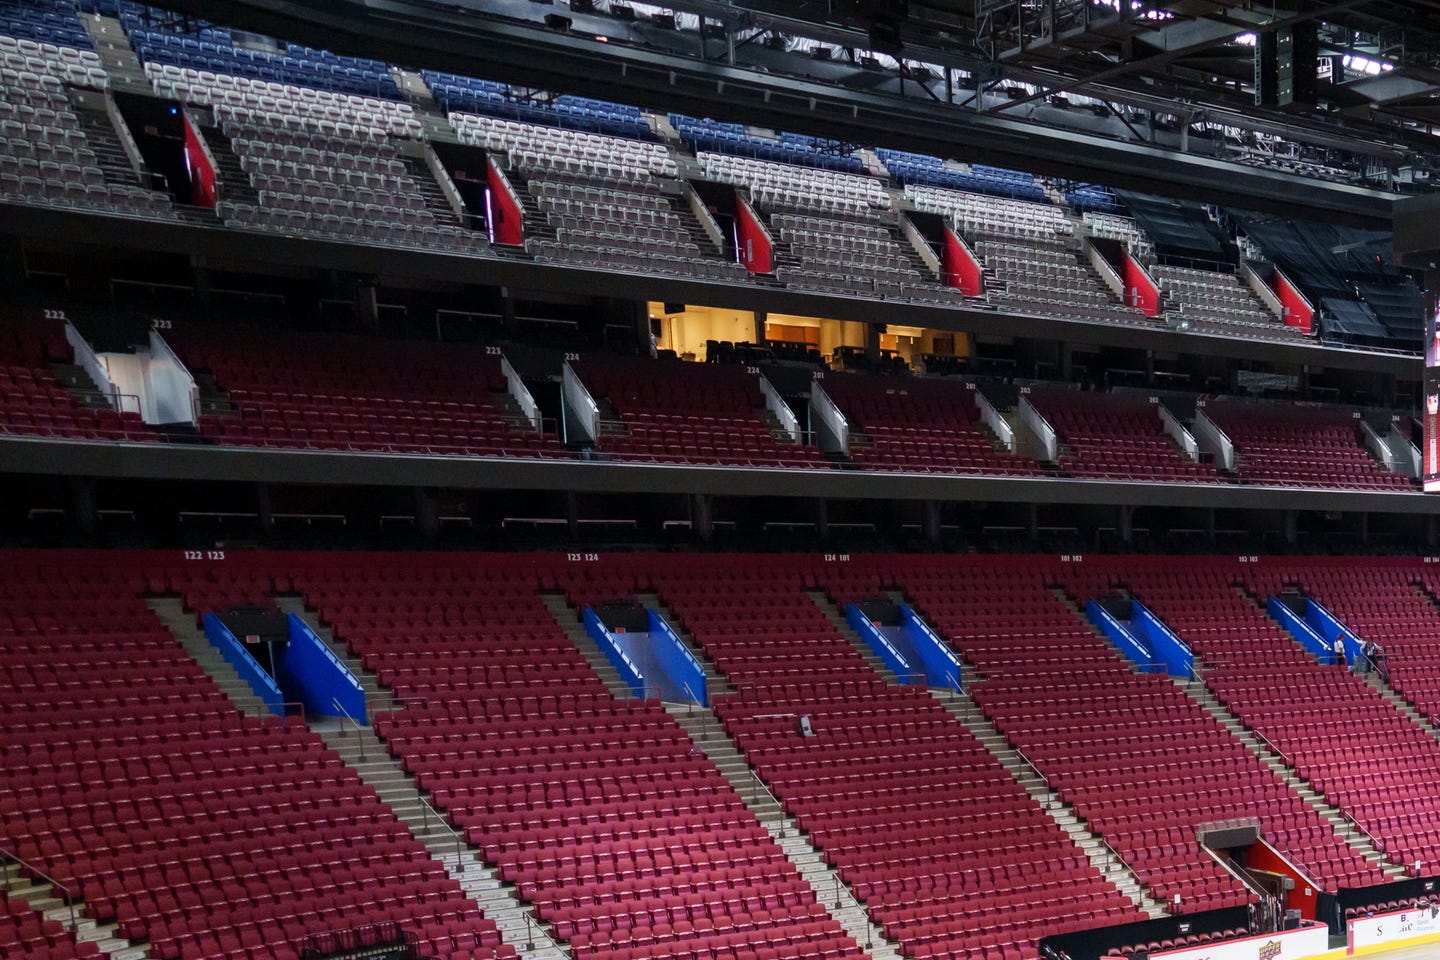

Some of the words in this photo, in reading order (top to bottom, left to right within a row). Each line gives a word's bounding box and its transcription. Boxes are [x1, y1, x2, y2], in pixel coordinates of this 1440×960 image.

[45, 309, 66, 319] 222
[154, 319, 173, 329] 223
[486, 346, 501, 355] 223
[565, 352, 580, 361] 224
[747, 366, 760, 375] 224
[813, 372, 825, 380] 201
[965, 383, 976, 391] 201
[185, 551, 203, 560] 122
[208, 551, 225, 560] 123
[567, 553, 581, 562] 123
[585, 553, 600, 562] 124
[824, 554, 836, 562] 124
[840, 554, 850, 562] 101
[1061, 555, 1070, 563] 101
[1073, 555, 1083, 563] 102
